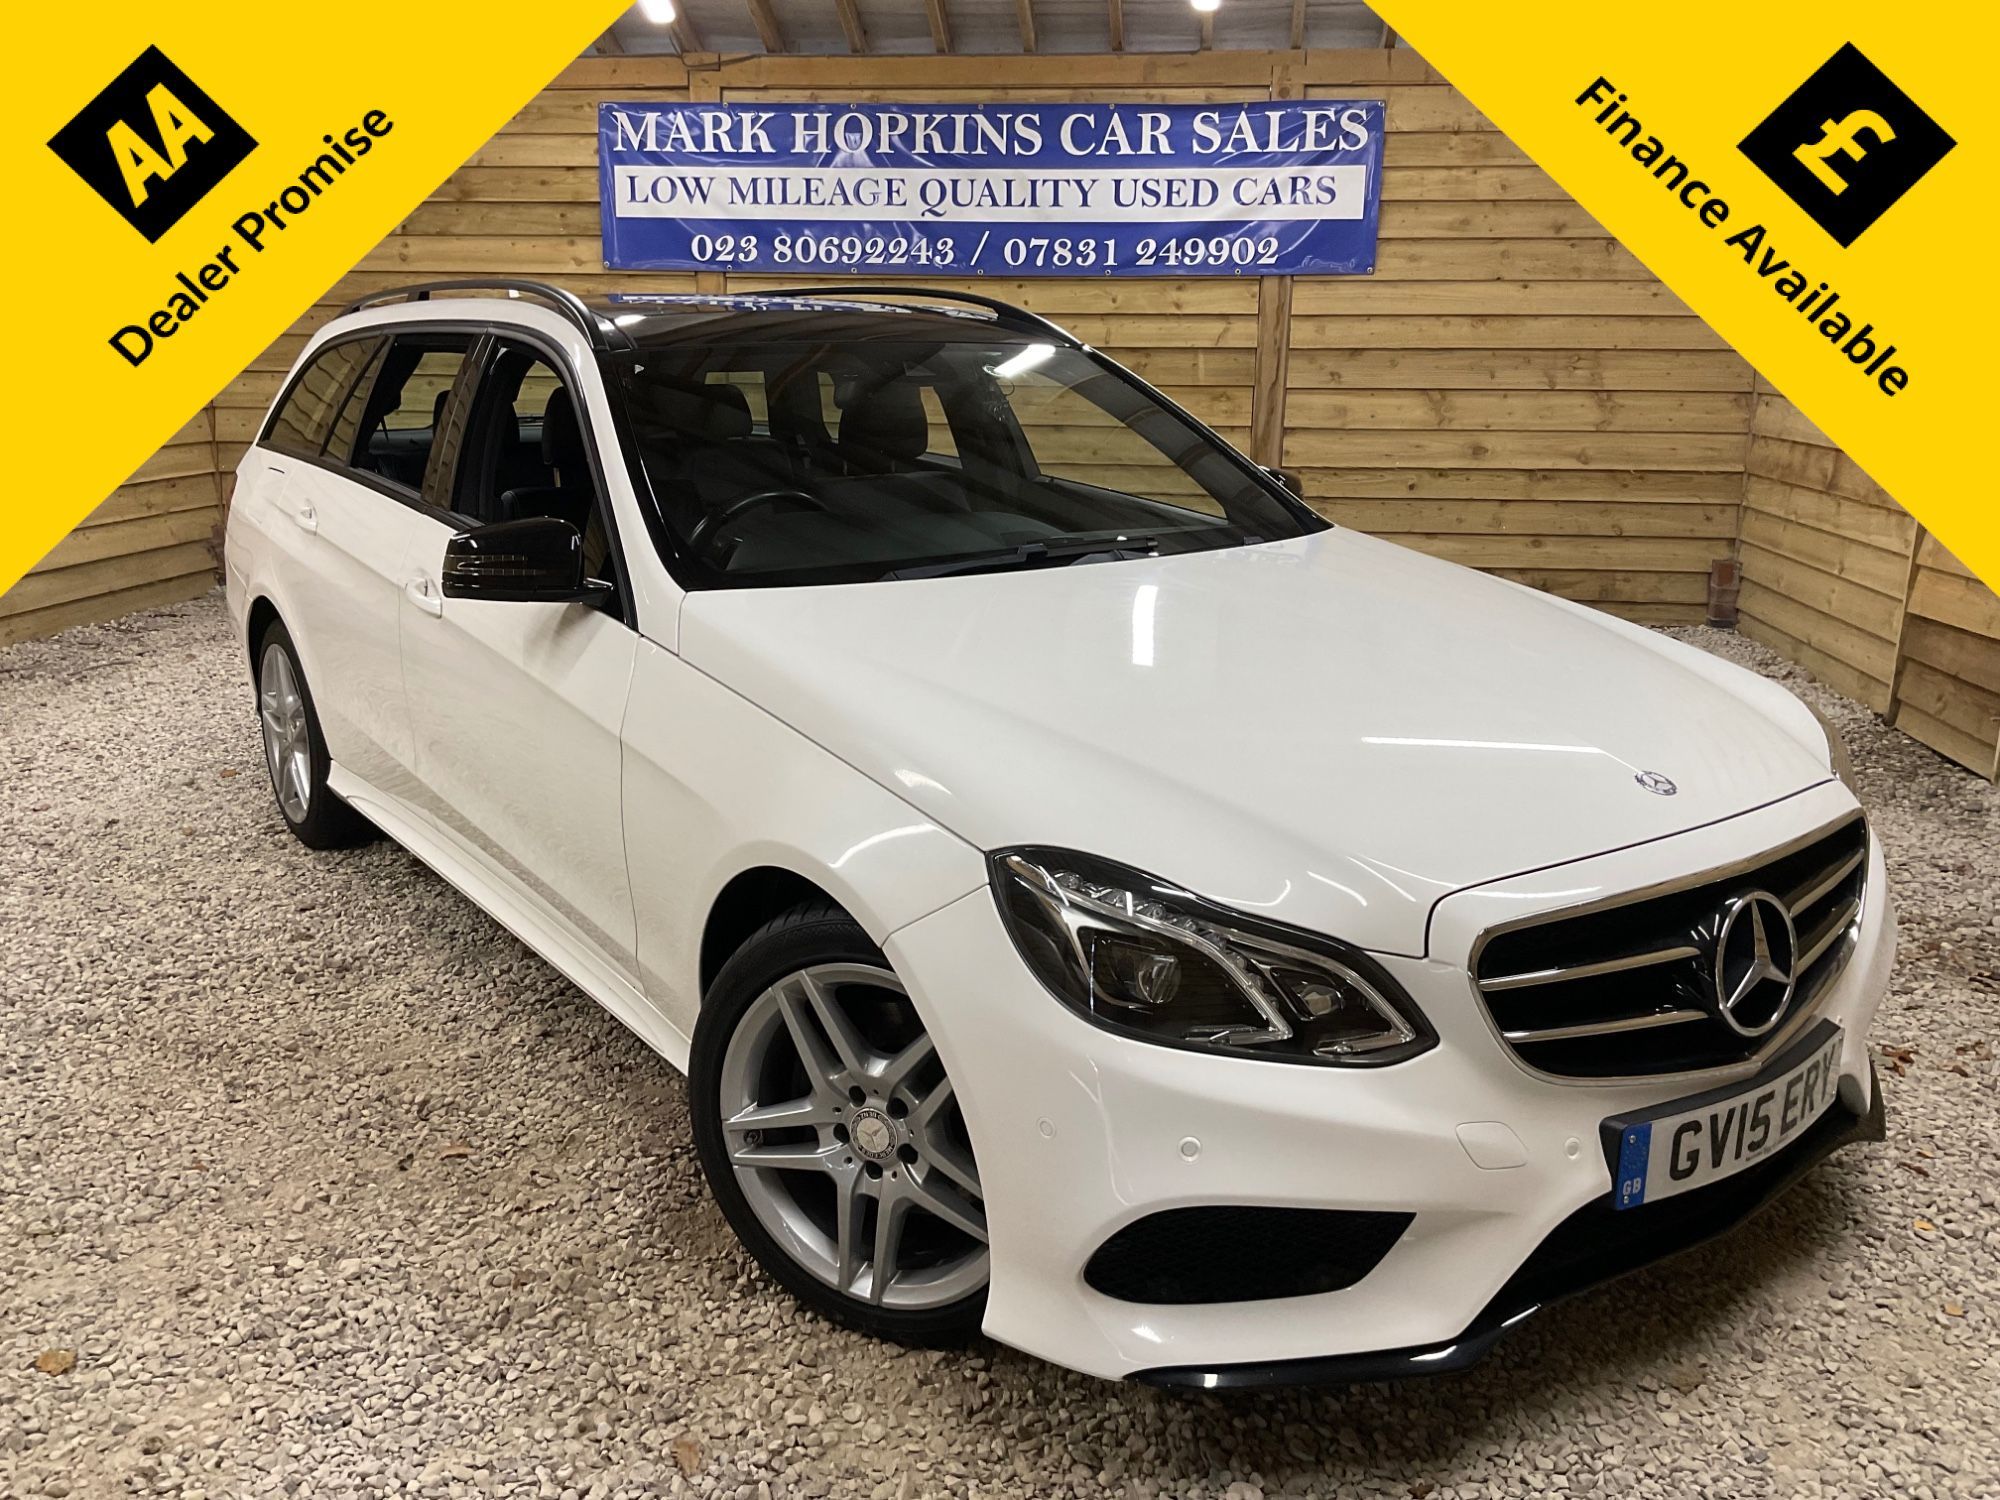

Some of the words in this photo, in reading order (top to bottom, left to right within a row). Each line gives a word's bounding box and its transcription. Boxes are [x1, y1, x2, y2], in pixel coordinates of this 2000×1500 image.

[612, 111, 776, 154] MARK
[790, 112, 1043, 156] HOPKINS
[1060, 111, 1175, 156] CAR
[1192, 108, 1369, 154] SALES
[627, 175, 717, 205] LOW
[729, 176, 907, 207] MILEAGE
[919, 177, 1099, 218] QUALITY
[1113, 177, 1219, 208] USED
[1232, 174, 1337, 206] CARS
[690, 234, 758, 263] 023
[773, 235, 955, 266] 80692243
[970, 230, 990, 266] /
[1003, 237, 1118, 267] 07831
[1135, 237, 1279, 266] 249902
[1668, 1090, 1776, 1182] GV15
[1780, 1043, 1837, 1137] ERY
[1622, 1176, 1642, 1196] GB
